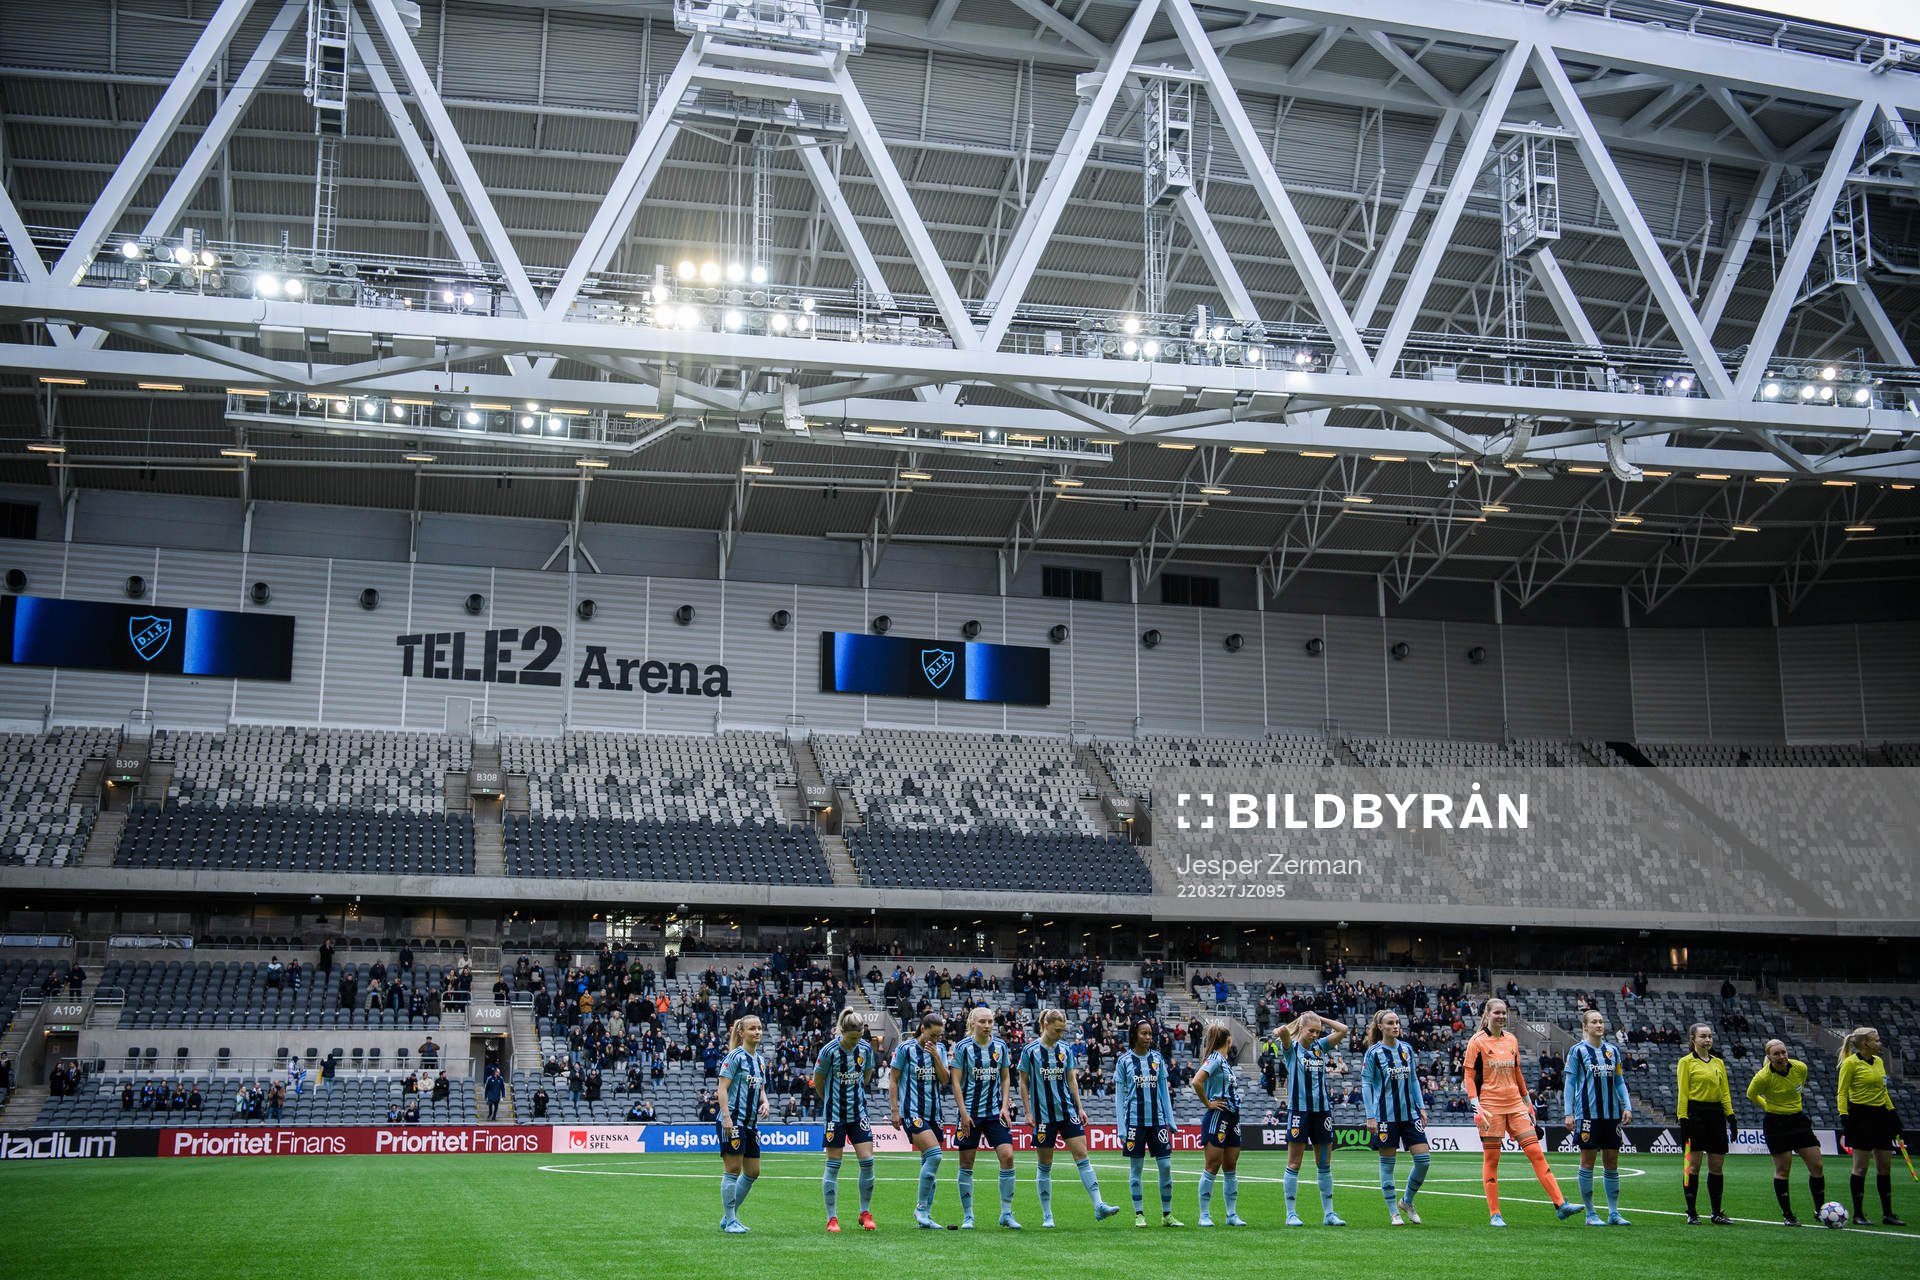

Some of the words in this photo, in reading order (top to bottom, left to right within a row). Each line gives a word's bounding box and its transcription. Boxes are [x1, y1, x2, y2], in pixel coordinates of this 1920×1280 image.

[396, 625, 563, 687] TELE2
[574, 645, 732, 698] Arena
[116, 759, 139, 769] B309
[476, 772, 498, 782] B308
[807, 786, 826, 795] B307
[1111, 798, 1130, 807] B306
[53, 1005, 83, 1016] A109
[475, 1008, 502, 1018] A108
[375, 1130, 468, 1153] Prioritet
[472, 1130, 539, 1152] Finans
[589, 1134, 629, 1142] SVENSKA
[663, 1131, 698, 1149] Heja
[1334, 1129, 1371, 1145] YOU
[0, 1131, 116, 1159] tadium
[174, 1132, 272, 1155] Prioritet
[276, 1131, 346, 1154] Finans
[589, 1142, 611, 1150] SPEL
[1649, 1144, 1683, 1153] adidas
